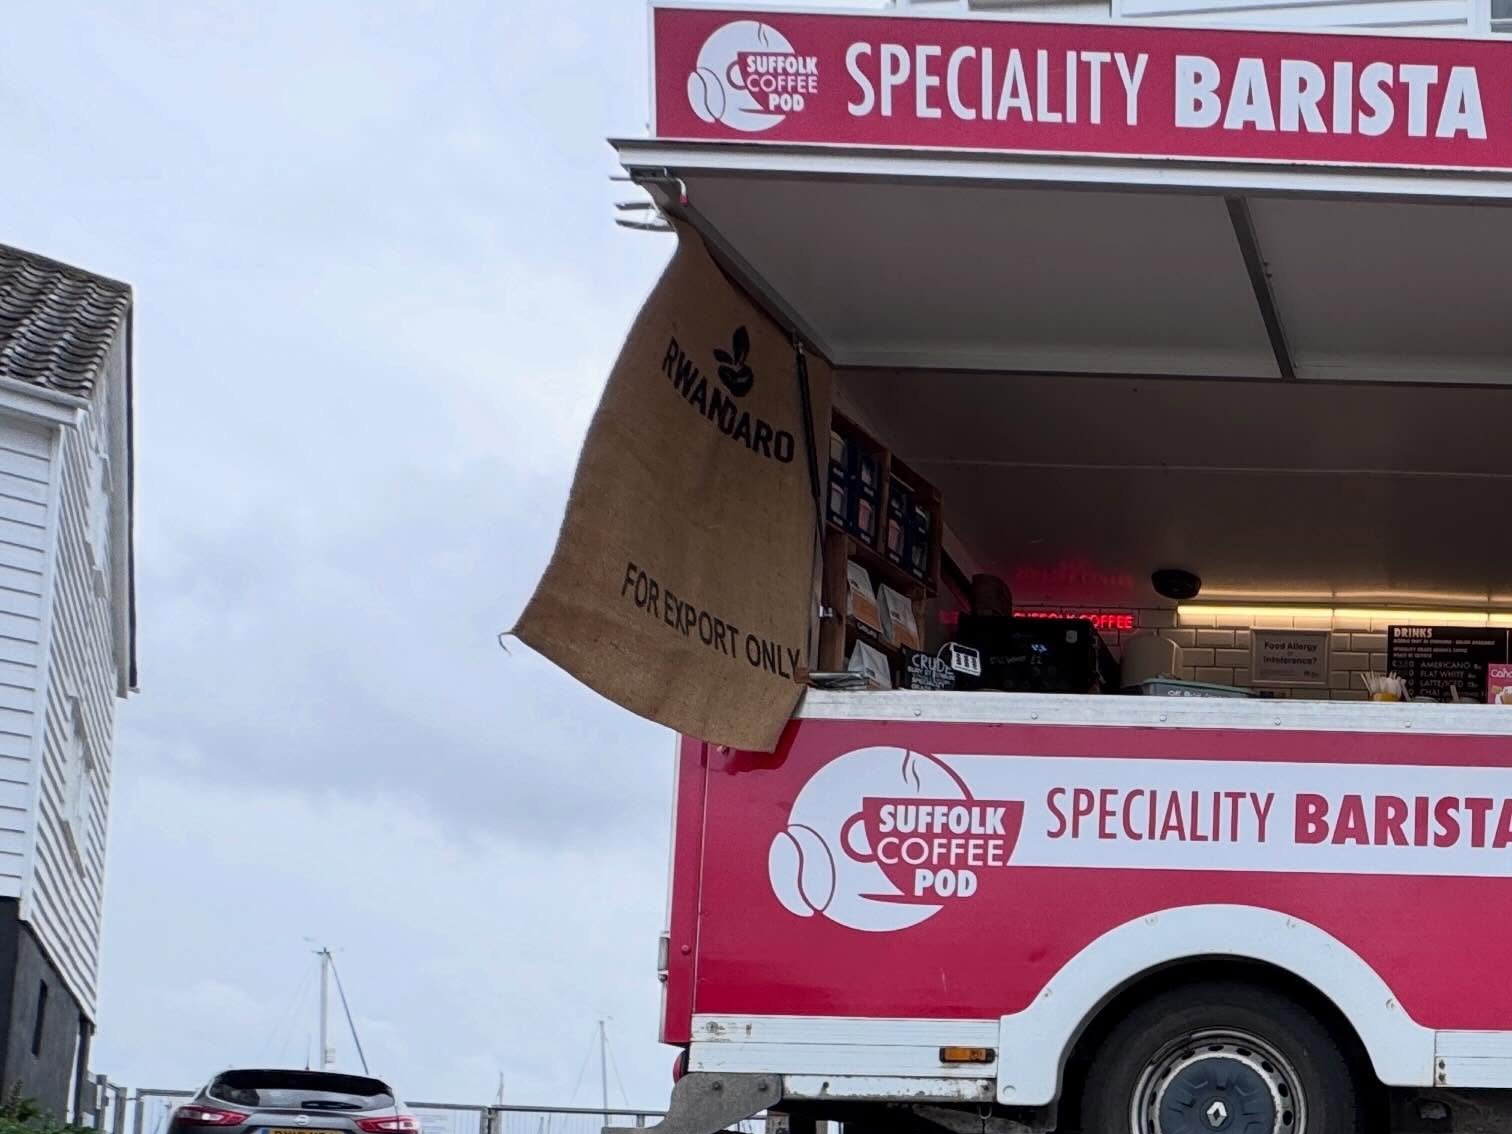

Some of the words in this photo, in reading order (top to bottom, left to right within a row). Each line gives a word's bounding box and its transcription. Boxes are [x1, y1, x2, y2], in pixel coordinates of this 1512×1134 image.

[746, 56, 819, 75] SUFFOLK
[747, 75, 818, 93] COFFEE
[845, 42, 1149, 127] SPECIALITY
[1175, 55, 1488, 139] BARISTA
[768, 93, 804, 111] POD
[621, 561, 660, 618] FOR
[664, 589, 739, 660] EXPORT
[745, 633, 800, 680] ONLY
[1393, 628, 1432, 638] DRINKS
[1264, 640, 1285, 650] Food
[1287, 640, 1318, 652] Allergy
[879, 804, 1006, 835] SUFFOLK
[1046, 787, 1275, 843] SPECIALITY
[877, 837, 1004, 866] COFFEE
[914, 869, 977, 897] POD
